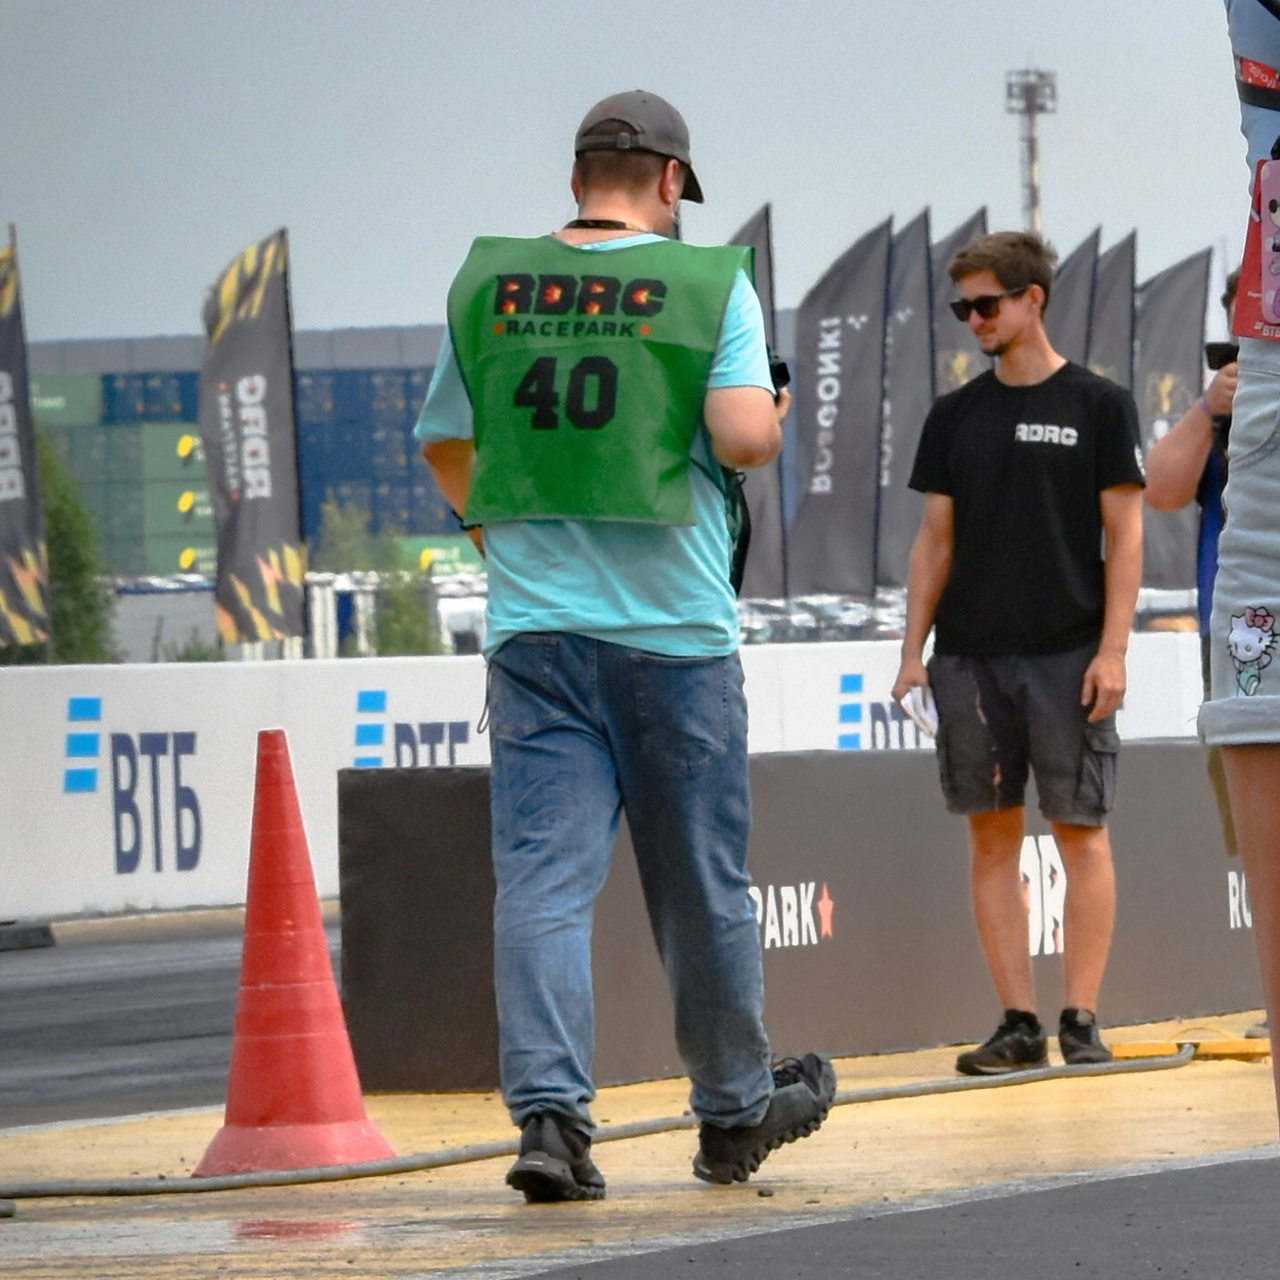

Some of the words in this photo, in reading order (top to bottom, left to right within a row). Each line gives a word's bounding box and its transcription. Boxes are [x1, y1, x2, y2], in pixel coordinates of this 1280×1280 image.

[494, 274, 667, 317] RDRC
[506, 320, 635, 338] RACEPARK
[513, 356, 619, 430] 40
[1015, 423, 1079, 446] RDRC
[109, 731, 203, 875] ВТБ
